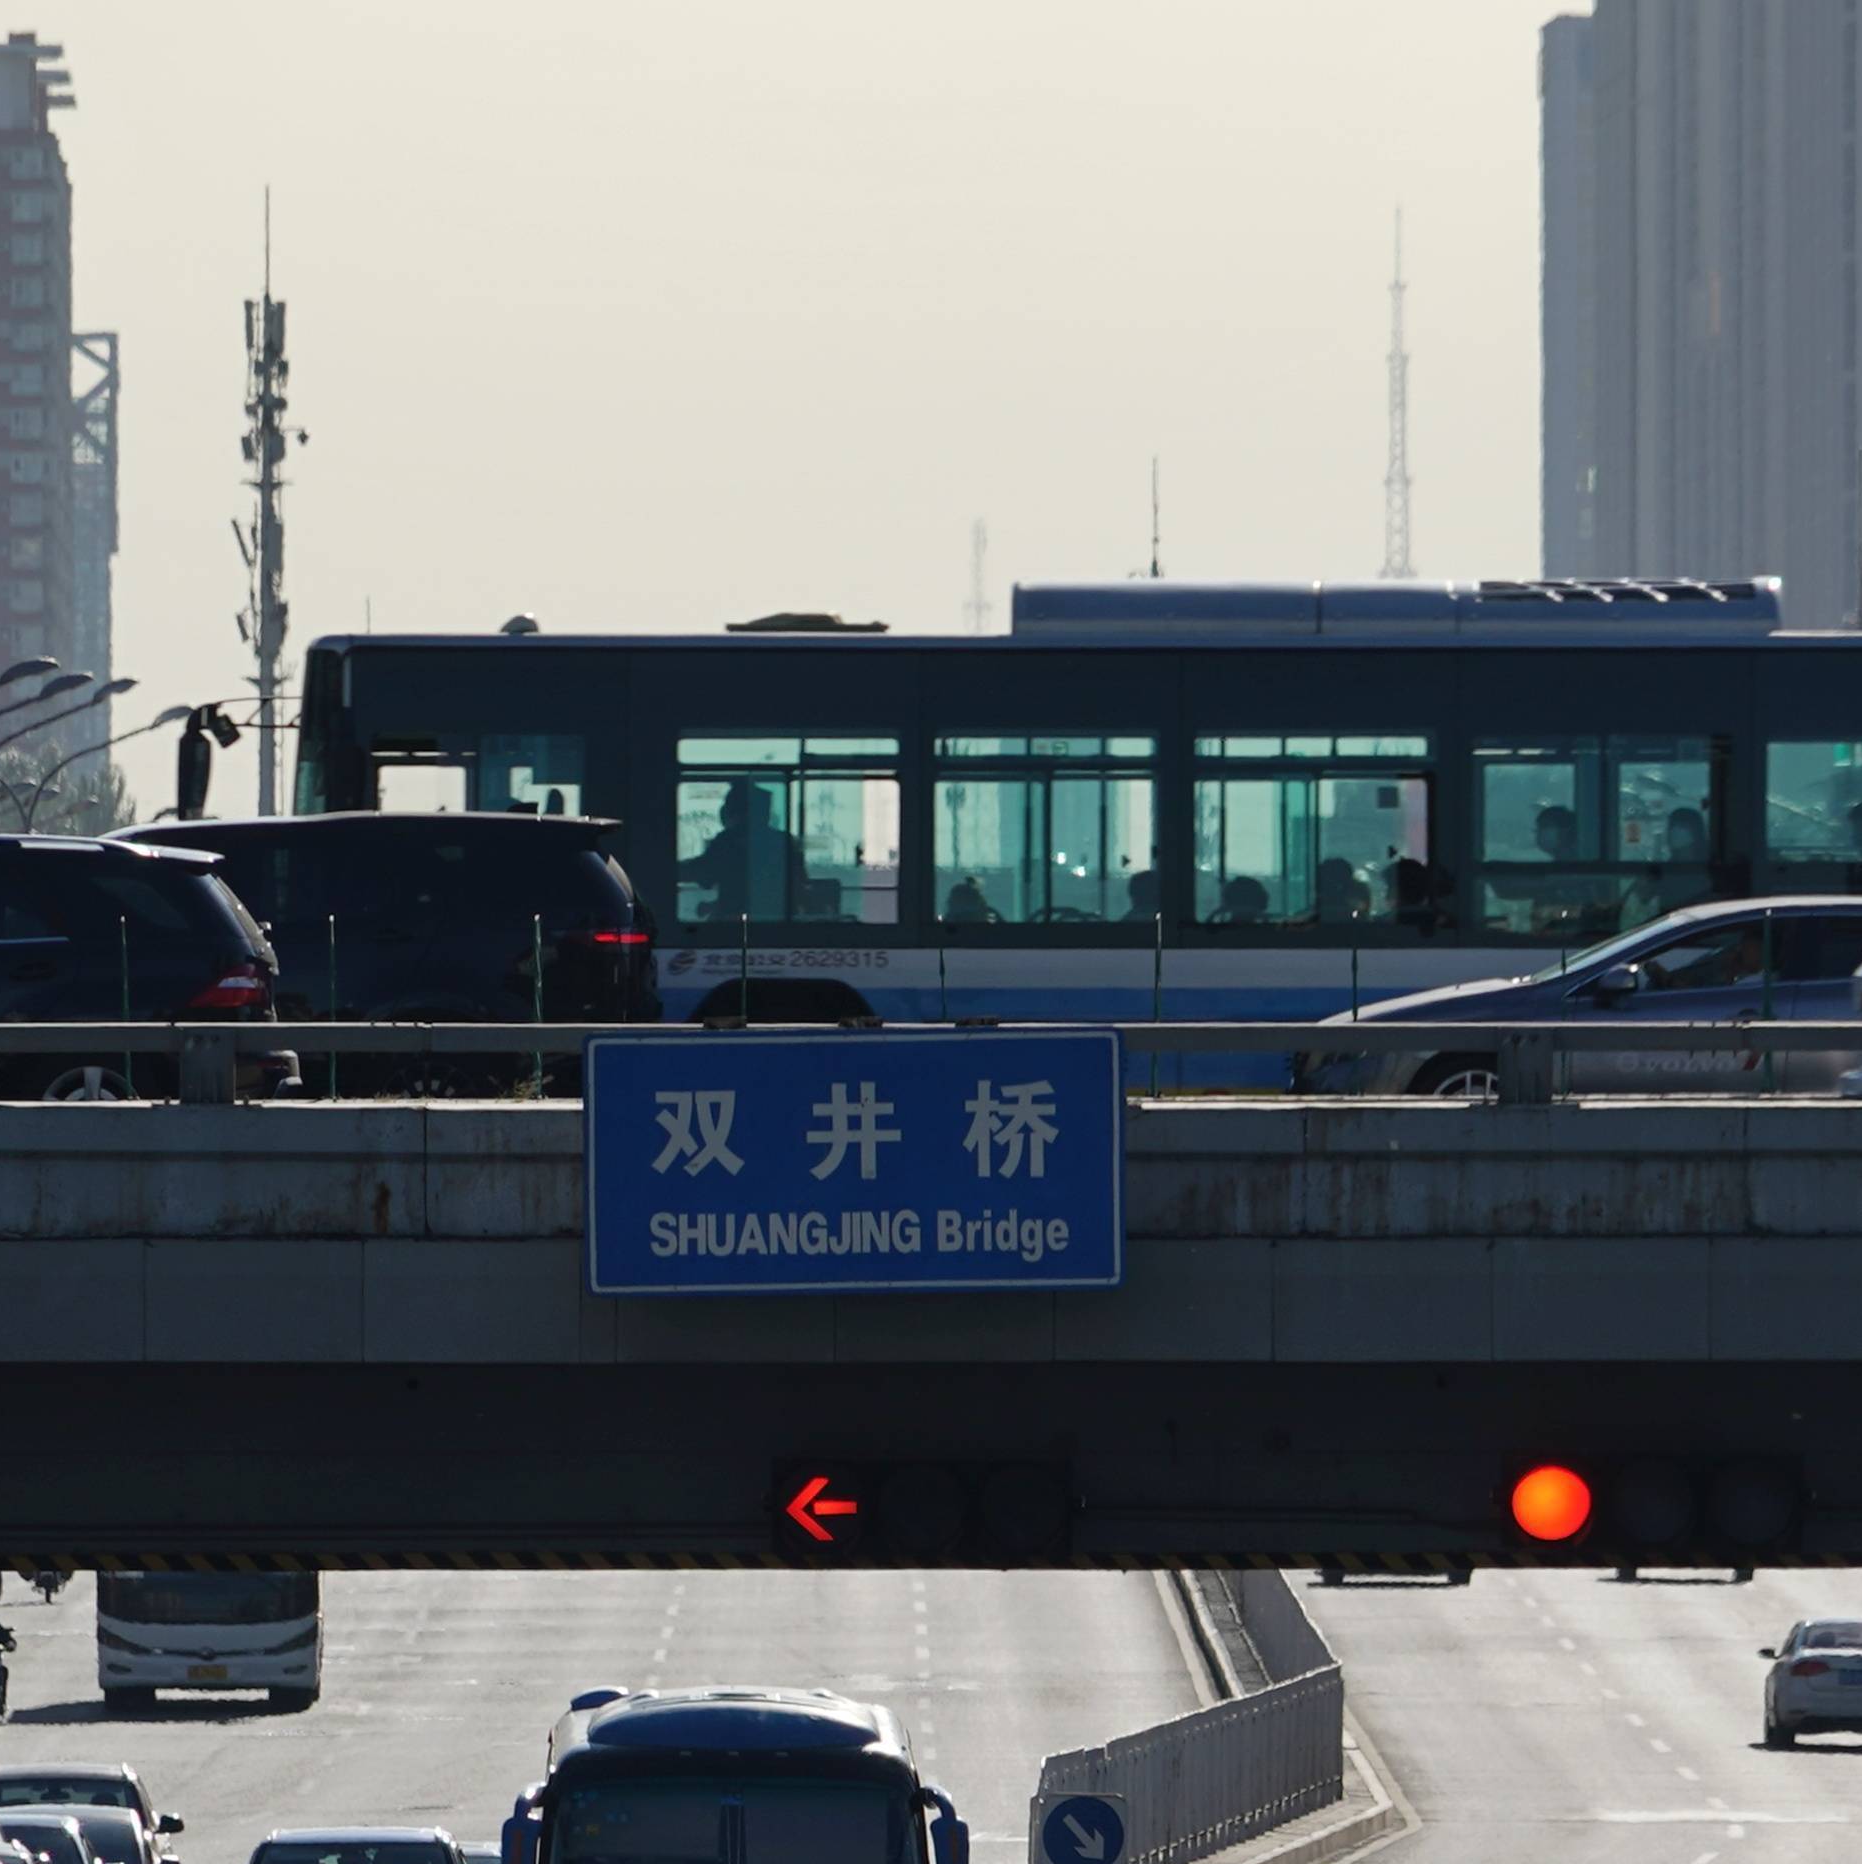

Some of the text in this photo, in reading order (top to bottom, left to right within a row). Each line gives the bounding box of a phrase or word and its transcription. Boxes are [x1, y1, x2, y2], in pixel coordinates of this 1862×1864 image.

[790, 950, 889, 968] 2629315
[650, 1079, 1060, 1180] 双井桥
[650, 1208, 1069, 1263] SHUANGJING Bridge
